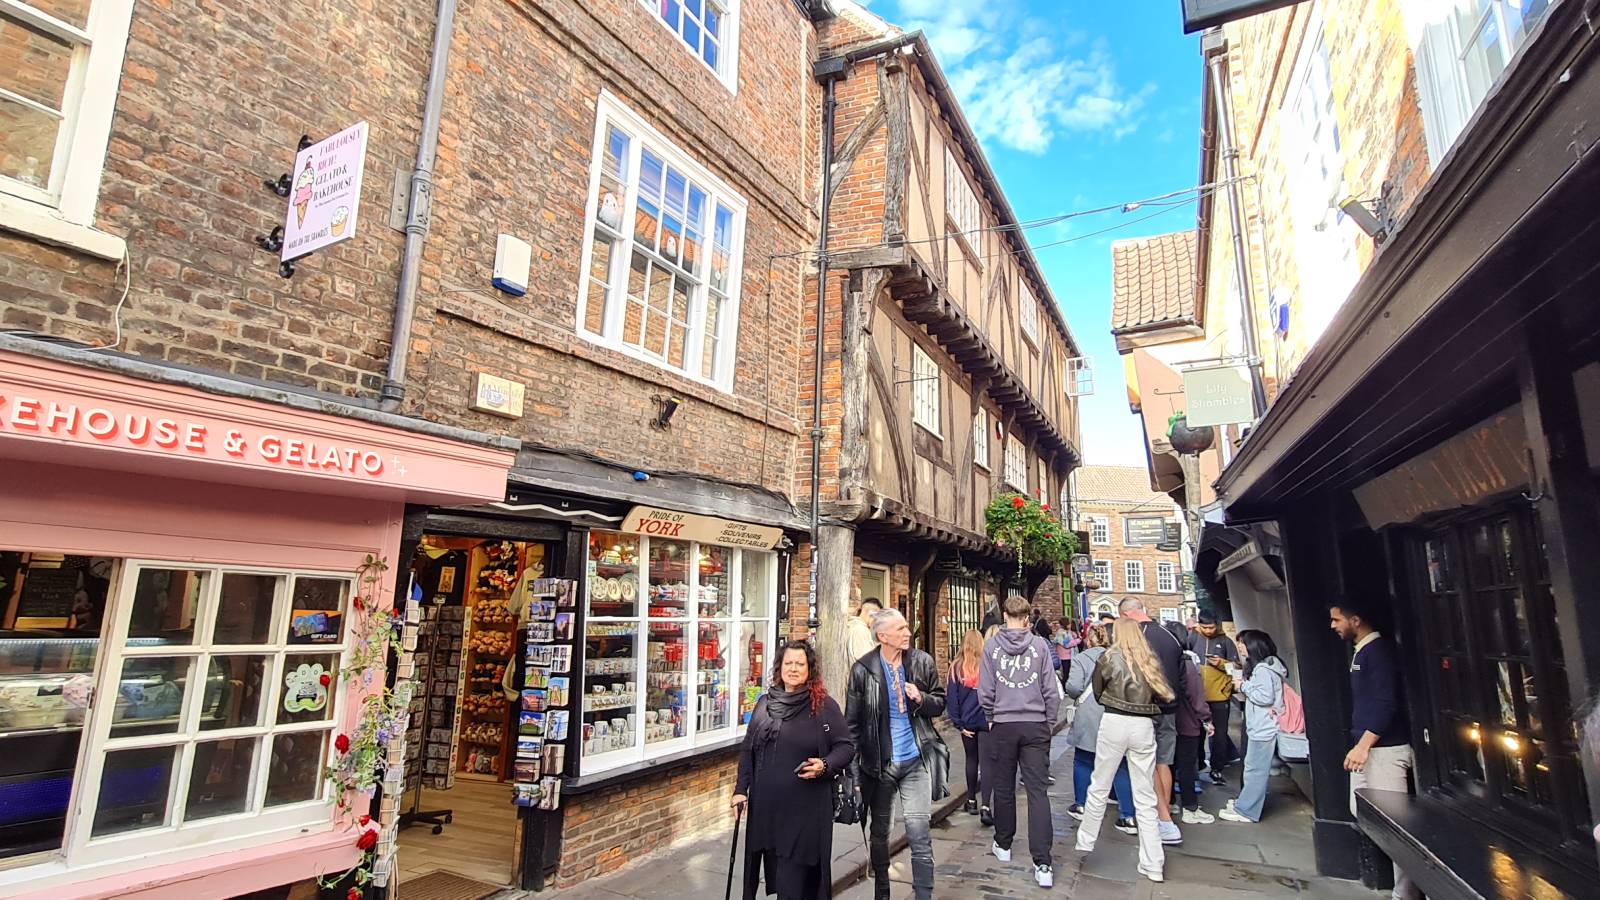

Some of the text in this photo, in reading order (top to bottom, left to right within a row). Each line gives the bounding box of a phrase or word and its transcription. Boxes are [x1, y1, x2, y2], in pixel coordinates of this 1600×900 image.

[223, 429, 247, 456] &
[257, 435, 385, 475] GELATO
[649, 510, 685, 522] PRIDE OF
[635, 518, 685, 536] YORK
[727, 523, 748, 531] GIFTS
[722, 529, 762, 540] SOUVENIRS
[718, 536, 769, 548] COLLECTABLES
[1017, 672, 1038, 688] CLUB
